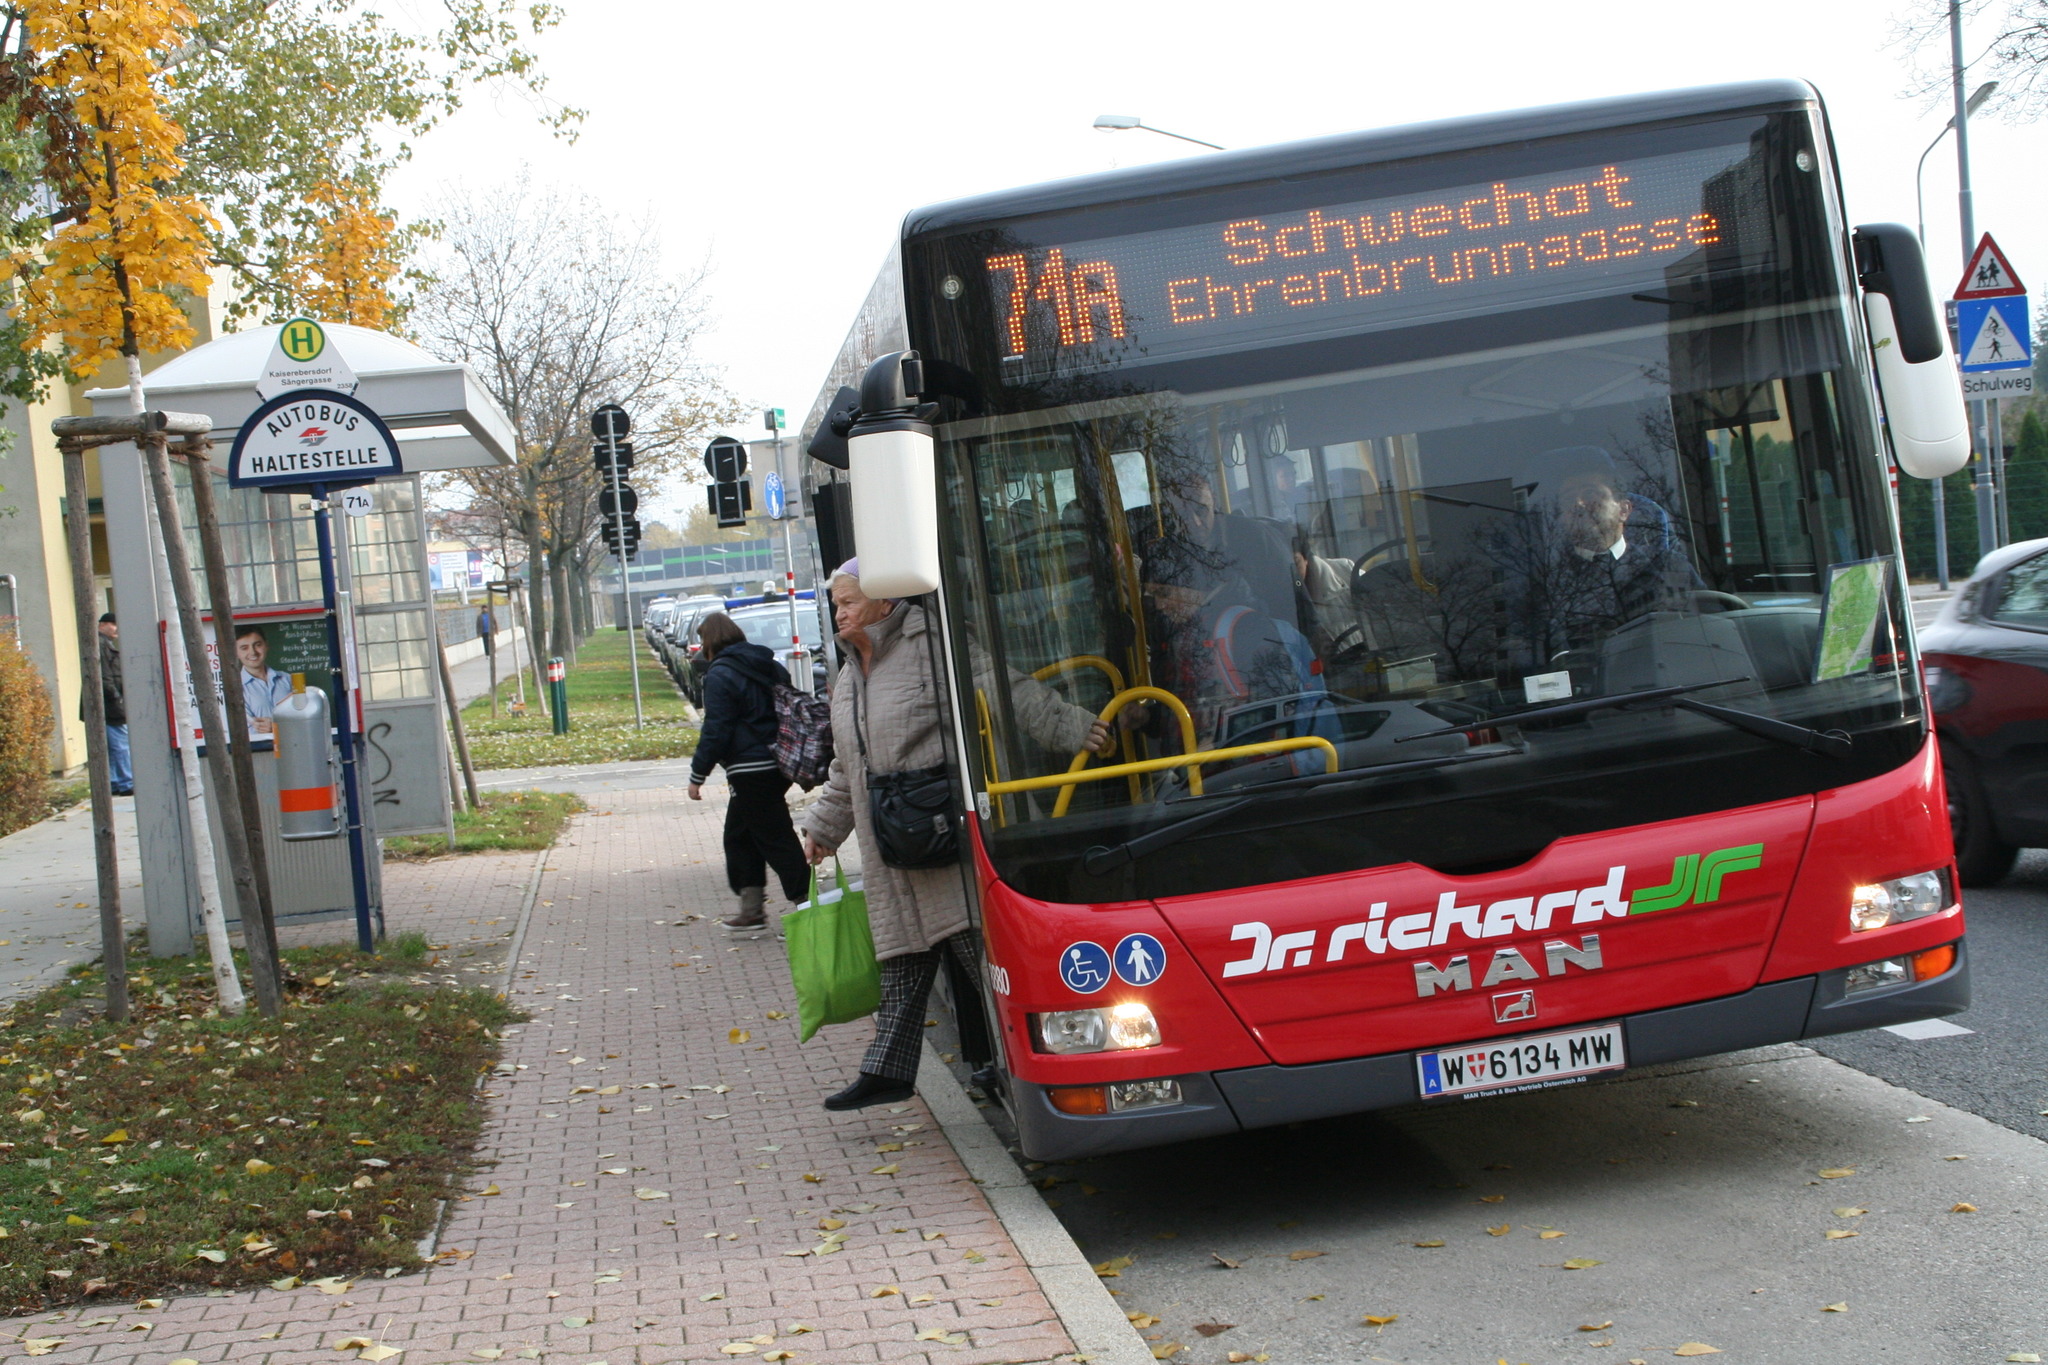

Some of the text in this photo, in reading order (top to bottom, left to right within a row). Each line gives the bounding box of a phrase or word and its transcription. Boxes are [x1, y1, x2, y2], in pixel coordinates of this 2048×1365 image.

[1222, 166, 1633, 266] Schwechat
[986, 214, 1719, 354] 71A Ehrenbrunngasse
[290, 327, 314, 354] H
[269, 367, 332, 378] Kaiserebersdorf
[281, 377, 332, 386] Sängergasse
[1963, 376, 2032, 393] Schulweg
[266, 404, 359, 438] AUTOBUS
[251, 447, 378, 473] HALTESTELLE
[1222, 865, 1629, 978] Dr. richard
[1413, 934, 1603, 998] MAN
[1443, 1033, 1611, 1086] W 6134 MW
[1429, 1078, 1437, 1088] A
[1463, 1092, 1479, 1100] MAN
[1480, 1089, 1497, 1097] Truck
[1504, 1086, 1517, 1094] Bus
[1518, 1083, 1542, 1092] Vertrieb
[1543, 1078, 1576, 1089] Österreich
[1577, 1075, 1587, 1083] AG
